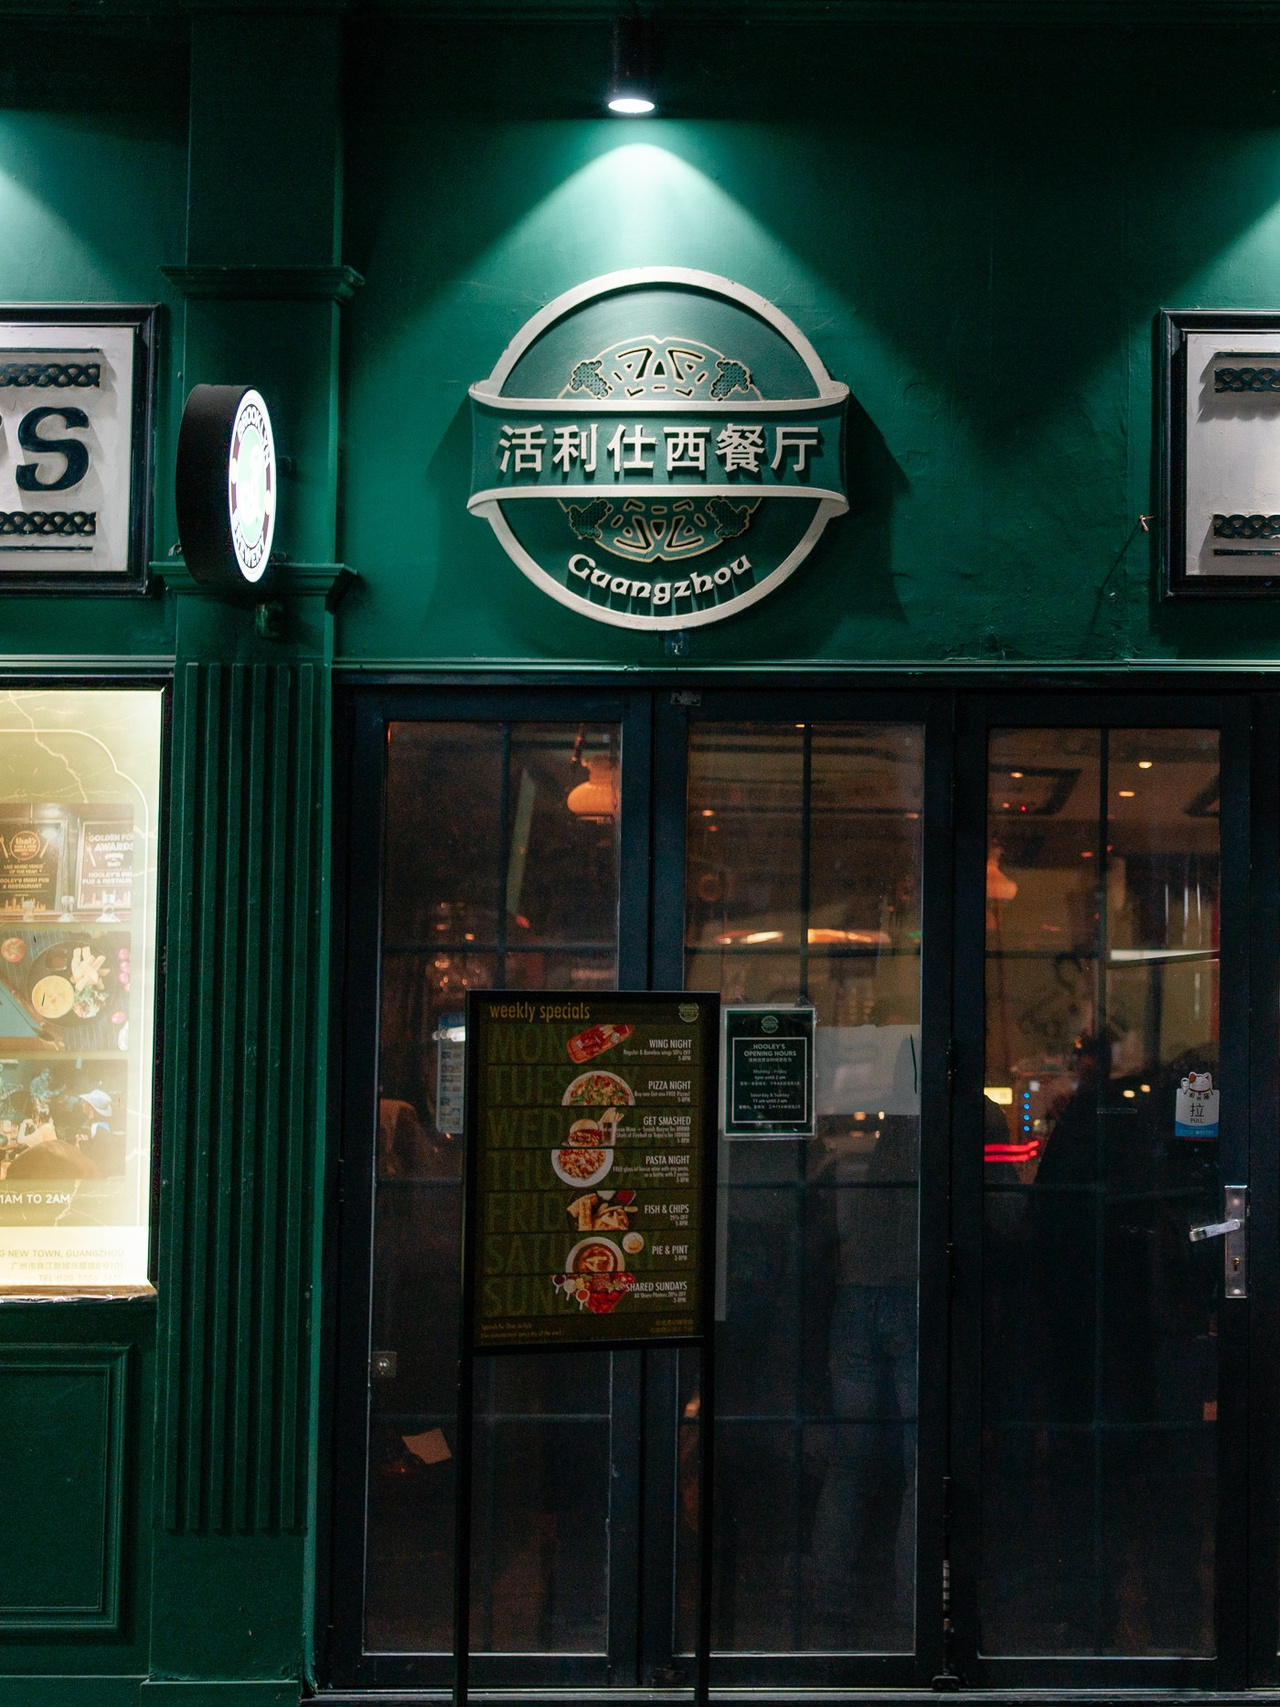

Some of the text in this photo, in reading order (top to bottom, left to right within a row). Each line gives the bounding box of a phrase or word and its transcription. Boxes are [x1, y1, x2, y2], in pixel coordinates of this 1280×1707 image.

[499, 422, 819, 473] 活利仕西餐厅
[567, 554, 752, 605] Guangzhou
[489, 1002, 590, 1022] weekly specials
[649, 1040, 692, 1048] WING NIGHT
[648, 1081, 691, 1090] PIZZA NIGHT
[1190, 1102, 1205, 1117] 拉
[643, 1116, 691, 1126] GET SMASHED
[646, 1156, 690, 1164] PASTA NIGHT
[26, 1194, 42, 1204] TO
[46, 1194, 71, 1204] 2AM
[644, 1204, 660, 1214] FISH
[669, 1204, 690, 1214] CHIPS
[8, 1250, 29, 1258] NEW
[66, 1250, 124, 1258] GUANGZHOU
[652, 1246, 663, 1254] PIE
[672, 1246, 688, 1254] PINT
[626, 1281, 688, 1292] SHARED SUNDAYS
